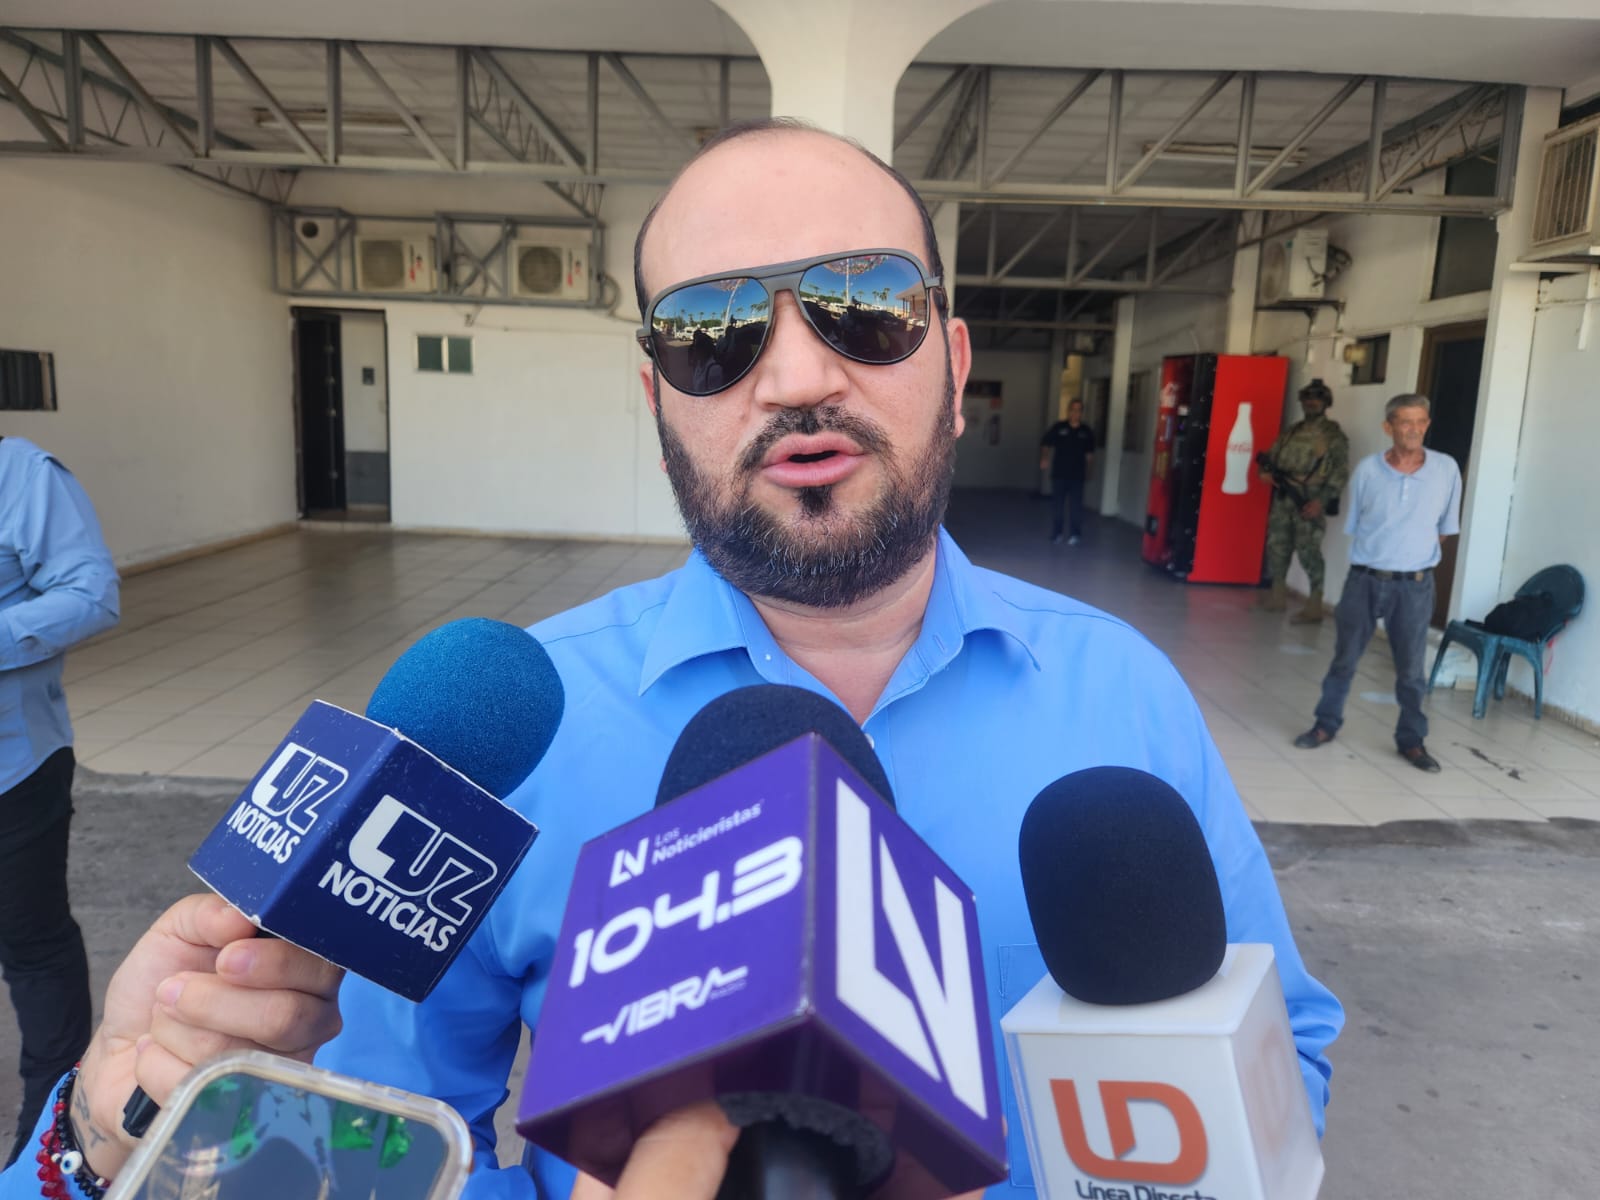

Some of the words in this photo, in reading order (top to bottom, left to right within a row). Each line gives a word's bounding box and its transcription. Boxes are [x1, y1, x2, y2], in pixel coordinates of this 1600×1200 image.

[226, 801, 300, 865] NOTICIAS
[651, 803, 761, 865] Noticieristas
[318, 860, 457, 952] NOTICIAS
[568, 836, 803, 988] 104.3
[581, 965, 748, 1044] VIBRA
